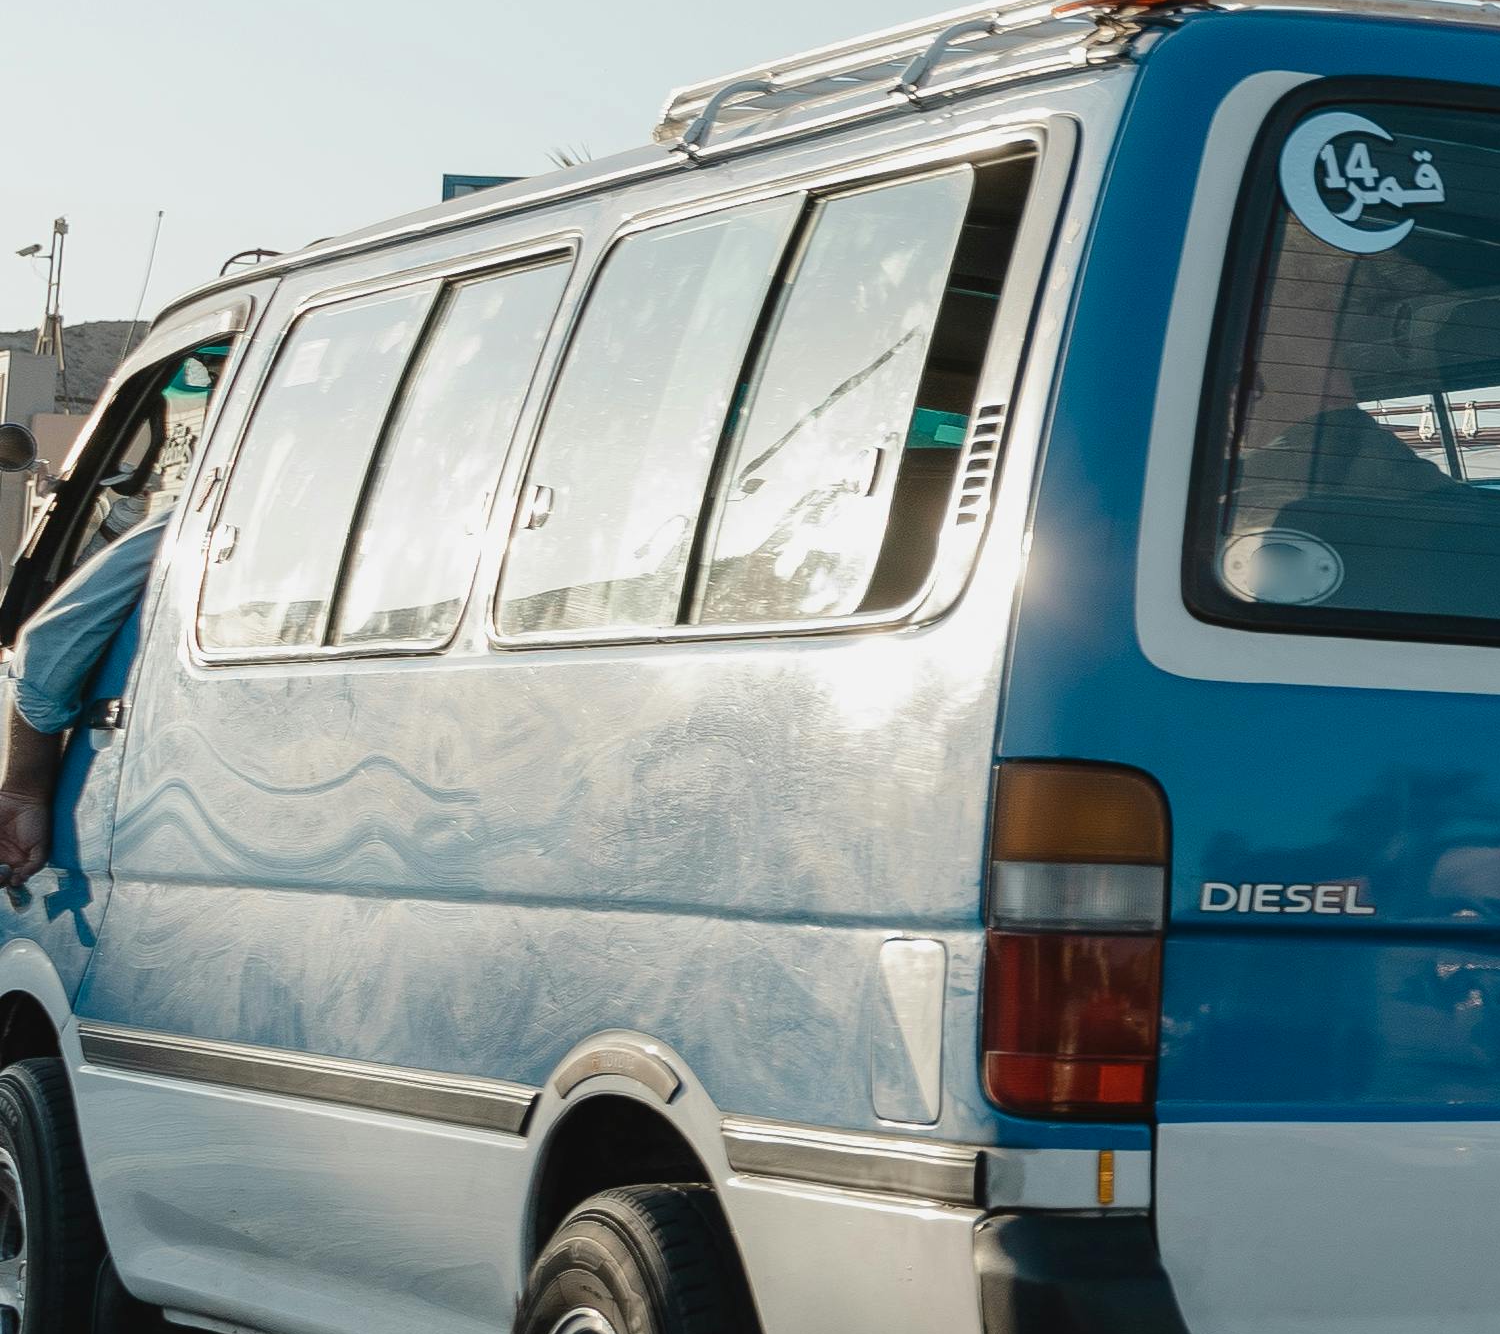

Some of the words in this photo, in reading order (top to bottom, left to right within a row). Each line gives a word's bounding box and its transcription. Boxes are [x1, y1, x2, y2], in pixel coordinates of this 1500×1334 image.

[1320, 142, 1380, 188] 14
[1334, 149, 1446, 222] قمر
[1200, 882, 1376, 915] DIESEL
